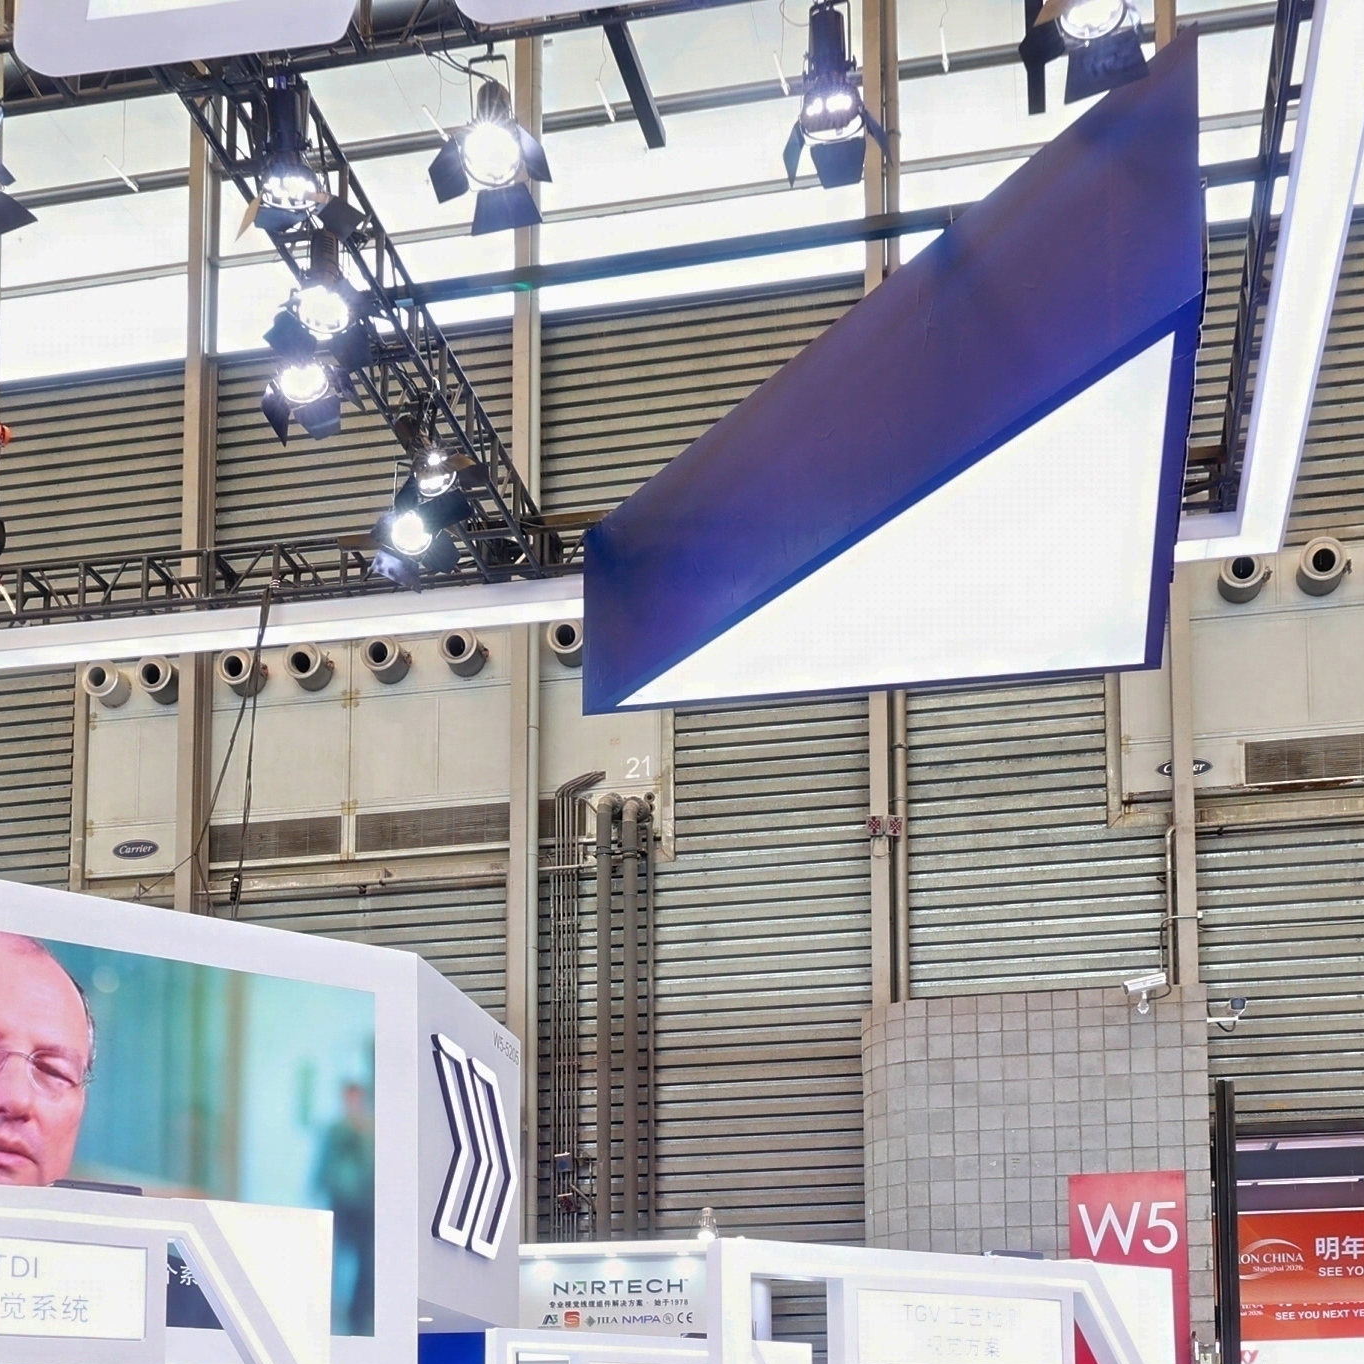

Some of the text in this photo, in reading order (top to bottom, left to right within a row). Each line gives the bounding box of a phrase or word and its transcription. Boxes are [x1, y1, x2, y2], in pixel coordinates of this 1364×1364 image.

[625, 755, 650, 779] 21
[119, 845, 153, 854] Carrier
[1078, 1202, 1179, 1256] W5
[1263, 1252, 1304, 1263] CHINA
[1252, 1264, 1304, 1273] Shanghai 2026
[1318, 1266, 1344, 1277] SEE
[622, 1315, 661, 1324] NMPA
[677, 1312, 693, 1324] CE
[903, 1304, 941, 1323] TGV
[1275, 1312, 1296, 1321] SEE
[1297, 1311, 1320, 1320] YOU
[1322, 1310, 1349, 1319] NEXT
